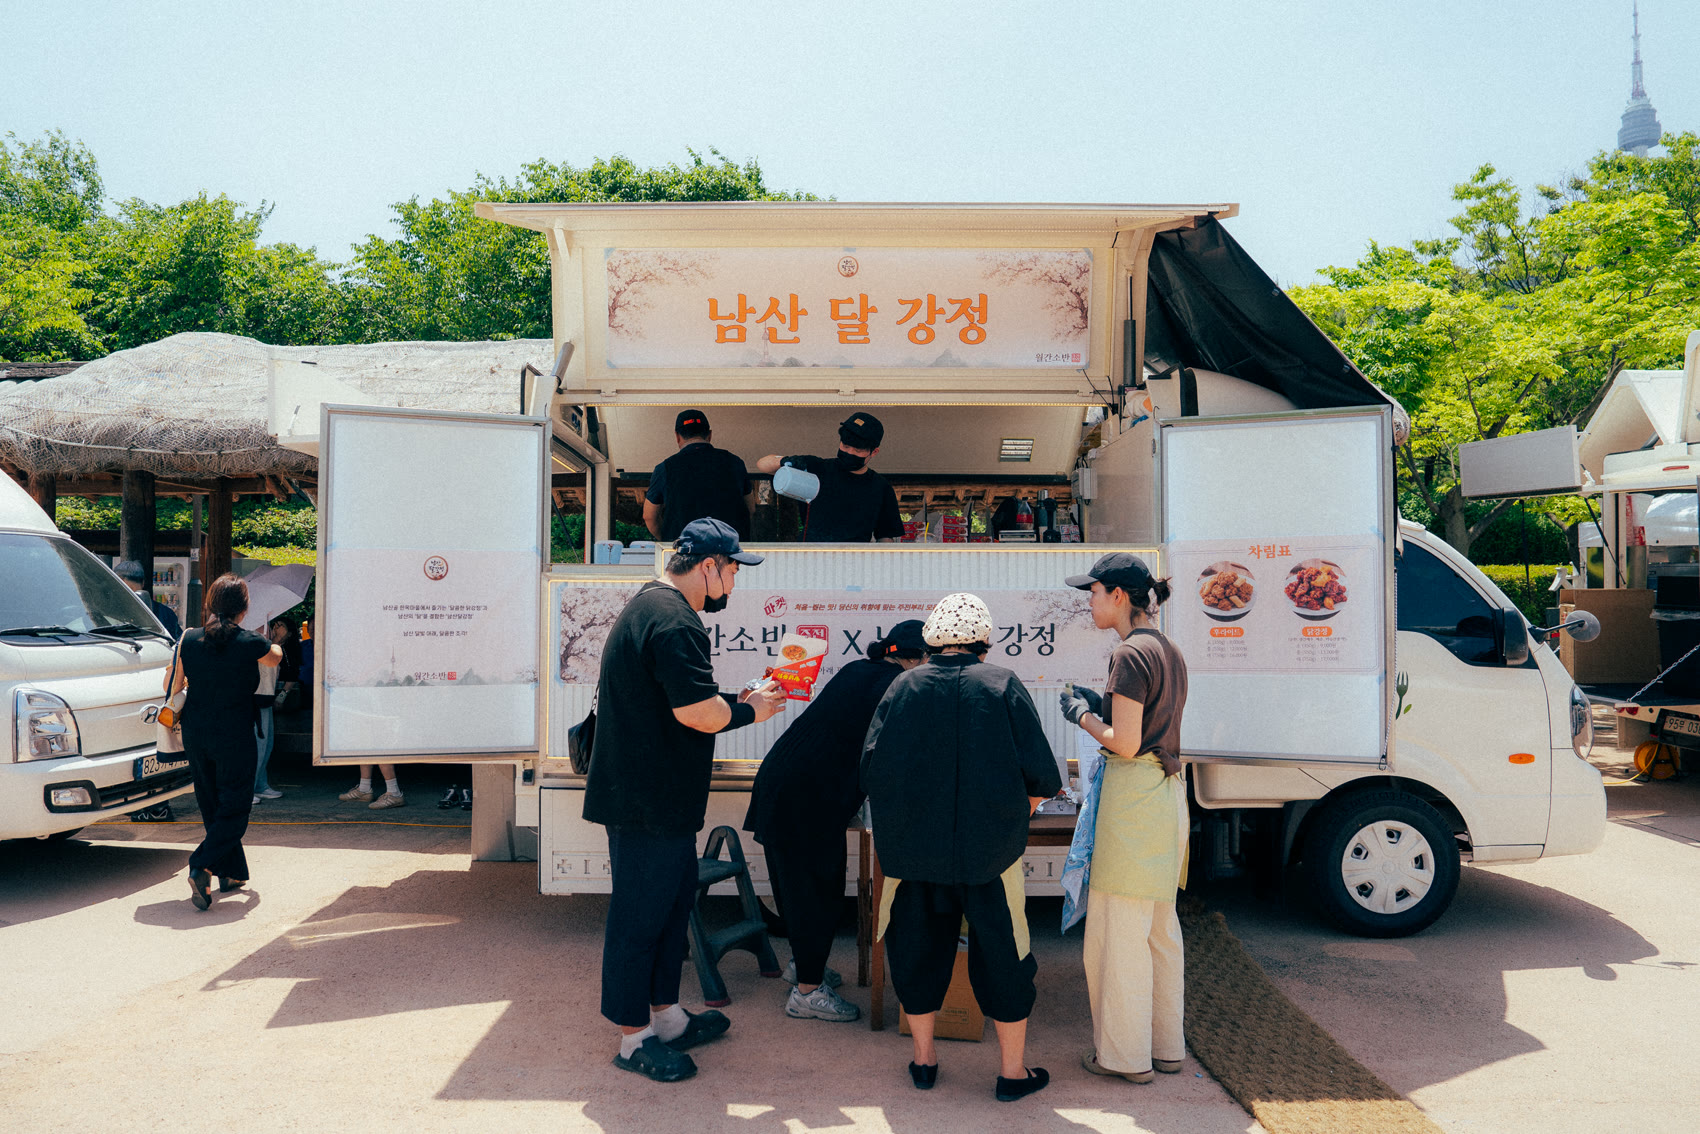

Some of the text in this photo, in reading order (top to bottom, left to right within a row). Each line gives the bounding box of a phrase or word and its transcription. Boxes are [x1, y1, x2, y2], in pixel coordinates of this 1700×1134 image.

[708, 293, 988, 345] 남산 달 강정
[1035, 353, 1070, 363] 월간소반
[1248, 544, 1292, 559] 차림표
[764, 596, 786, 616] 마켓
[839, 603, 859, 611] 당신의
[860, 603, 880, 611] 취향에
[897, 603, 925, 611] 주전부리
[1306, 627, 1328, 636] 닭강정
[997, 623, 1055, 657] 강정
[414, 671, 446, 681] 월간소반
